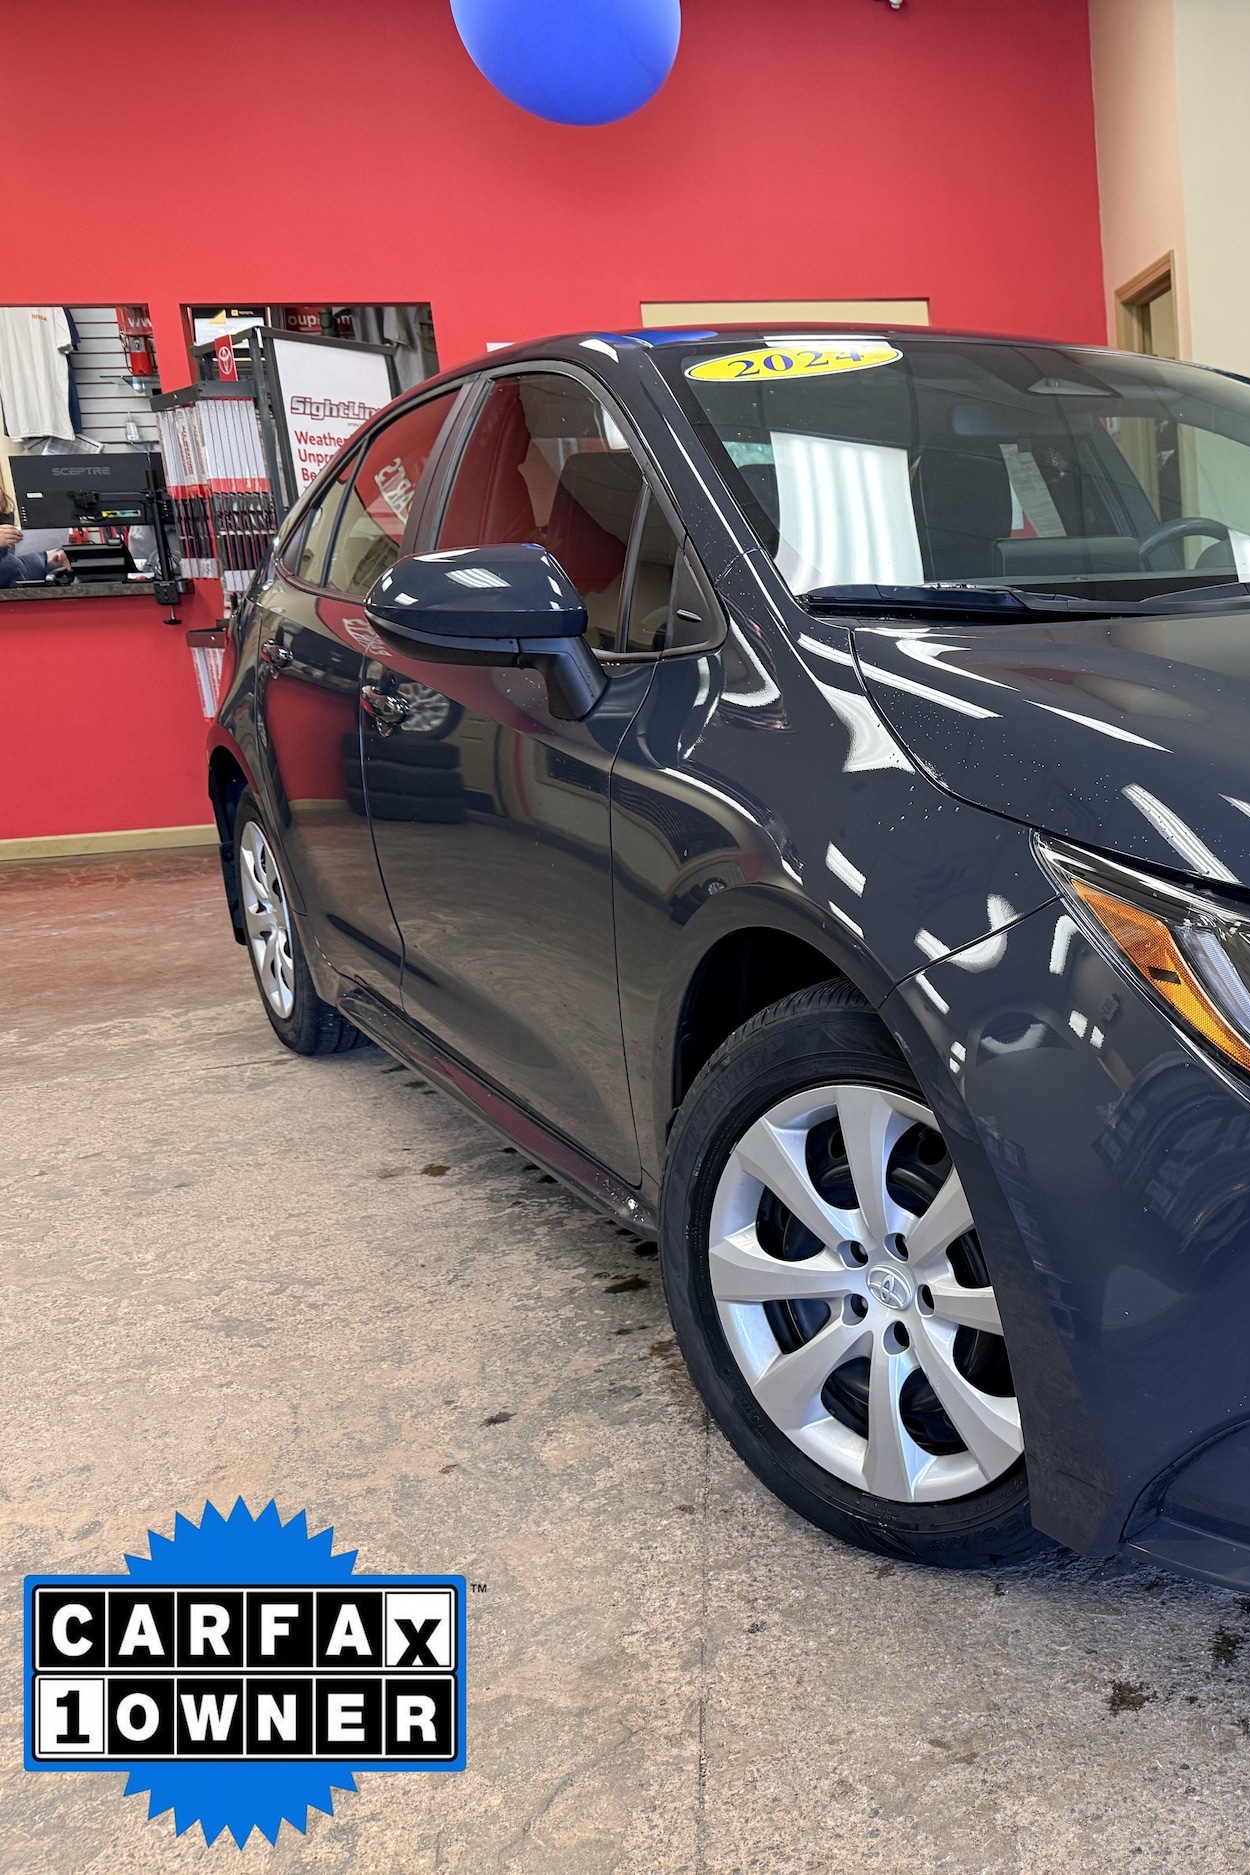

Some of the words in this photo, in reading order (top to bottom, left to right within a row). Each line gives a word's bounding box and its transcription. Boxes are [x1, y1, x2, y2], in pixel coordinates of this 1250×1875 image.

[728, 347, 865, 378] 2024
[290, 395, 379, 421] SightLin
[52, 466, 111, 476] SCEPTRE
